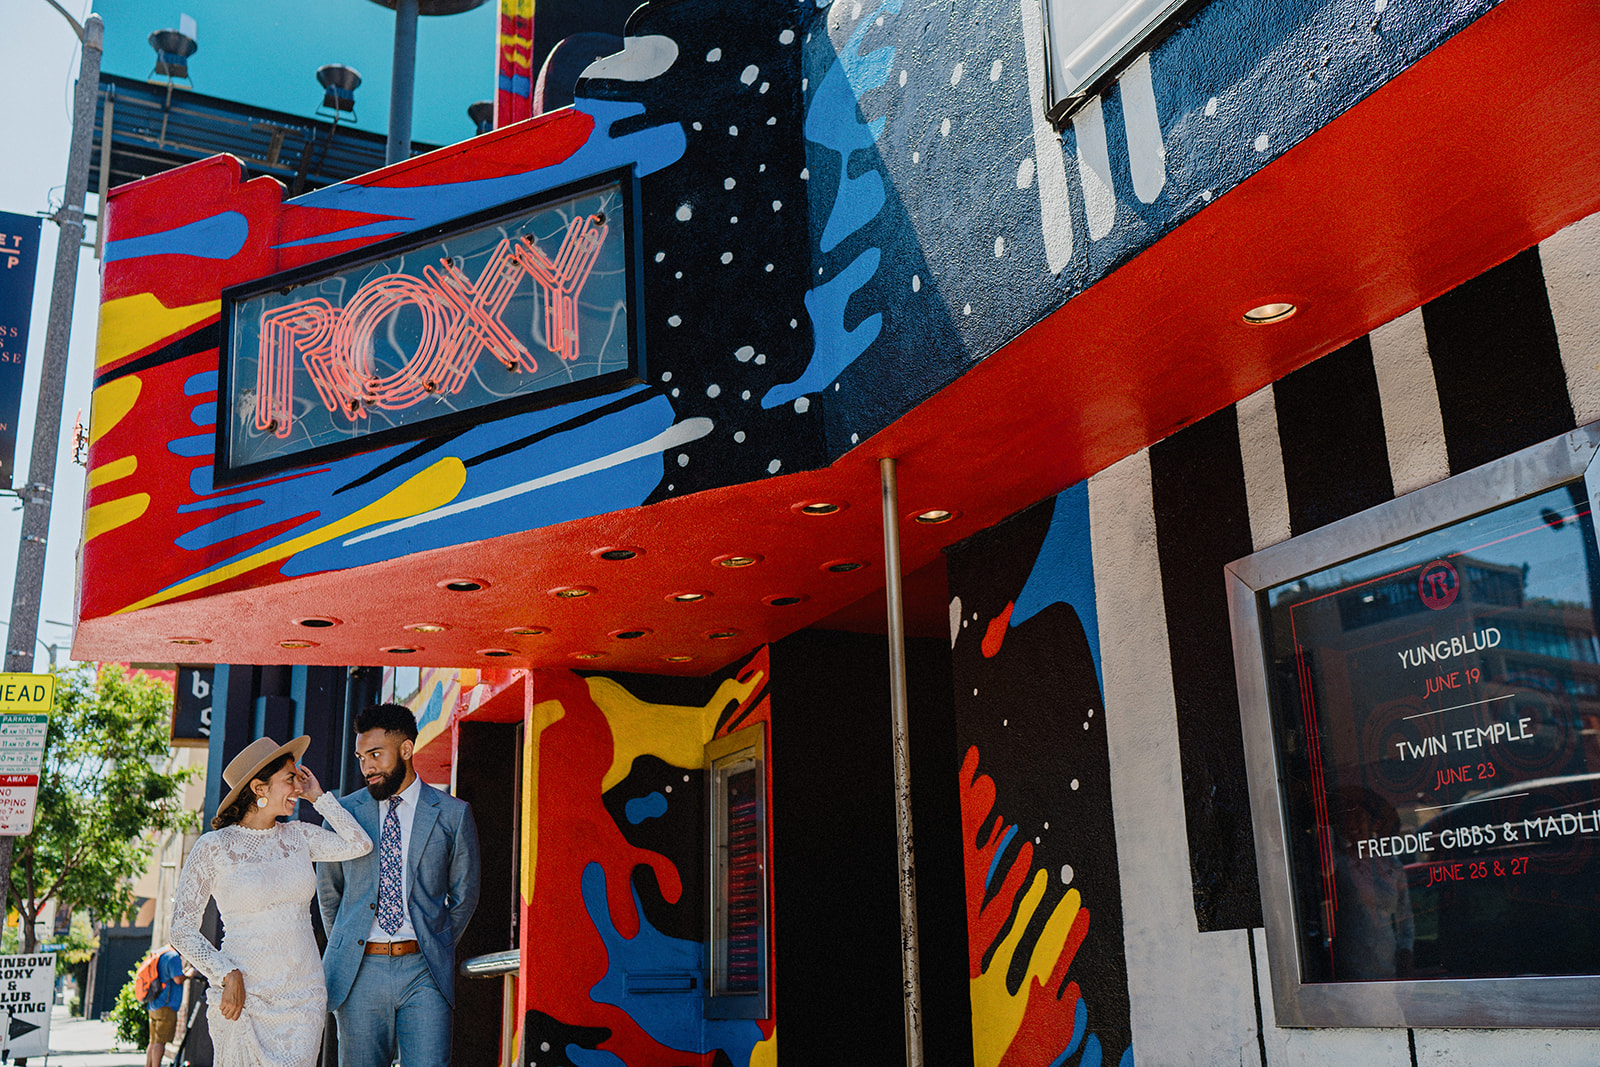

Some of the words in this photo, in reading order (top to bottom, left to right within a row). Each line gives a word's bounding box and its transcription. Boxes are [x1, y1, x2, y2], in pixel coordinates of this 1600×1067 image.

[255, 212, 609, 439] ROXY
[1397, 627, 1502, 670] YUNGBLUD
[1423, 671, 1461, 700] JUNE
[1465, 667, 1481, 686] 19
[2, 715, 37, 723] PARKING
[26, 727, 34, 735] 10
[1395, 734, 1448, 762] TWIN
[1452, 717, 1534, 751] TEMPLE
[6, 775, 28, 783] AWAY
[1434, 765, 1472, 791] JUNE
[1477, 762, 1496, 780] 23
[1357, 831, 1435, 860] FREDDIE
[1440, 824, 1497, 850] GIBBS
[1503, 821, 1519, 842] &
[1426, 863, 1464, 888] JUNE
[1469, 861, 1488, 879] 25
[1493, 860, 1506, 877] &
[1510, 857, 1530, 876] 27
[0, 968, 34, 980] OXY
[7, 980, 17, 991] &
[0, 1002, 46, 1014] KING
